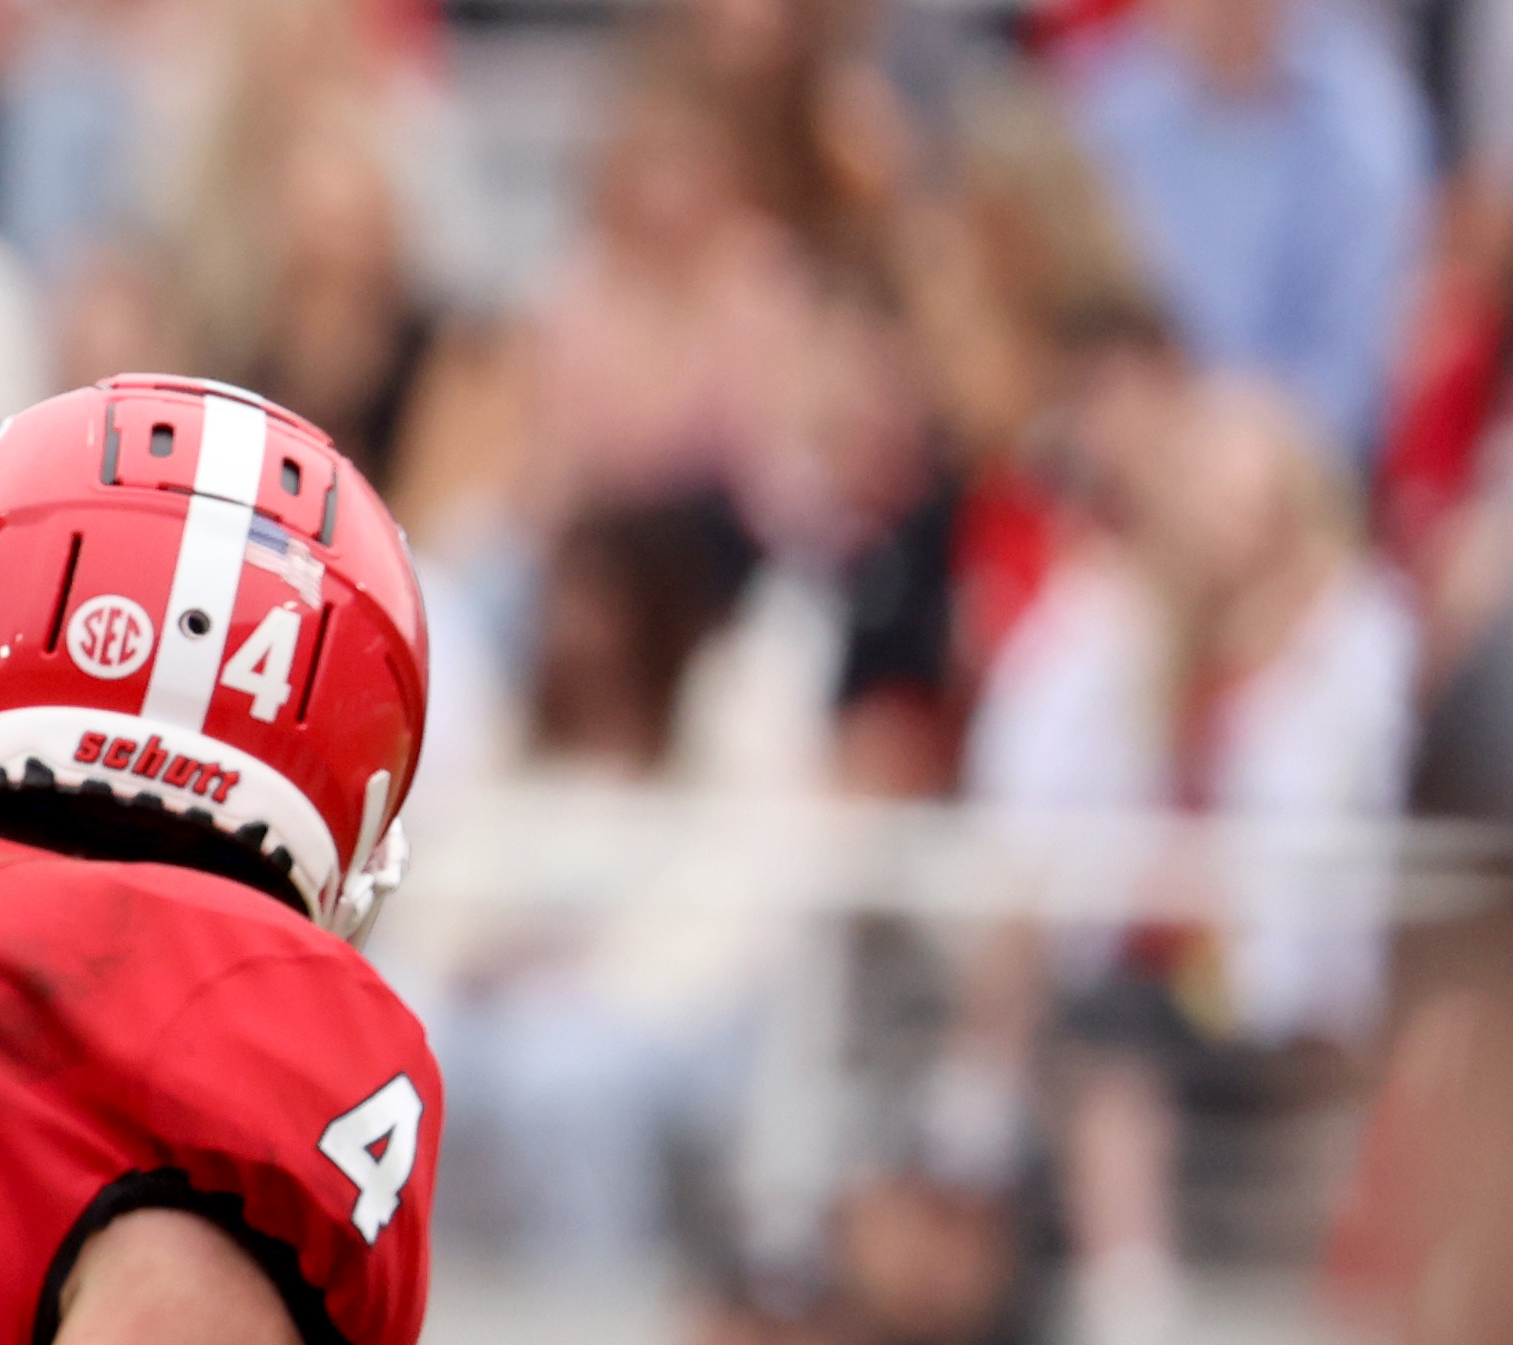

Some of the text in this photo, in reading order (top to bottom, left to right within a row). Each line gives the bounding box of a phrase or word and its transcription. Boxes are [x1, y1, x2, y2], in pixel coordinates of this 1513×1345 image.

[81, 607, 142, 665] SEC
[221, 605, 302, 723] 4
[73, 731, 242, 802] schutt
[317, 1071, 425, 1247] 4
